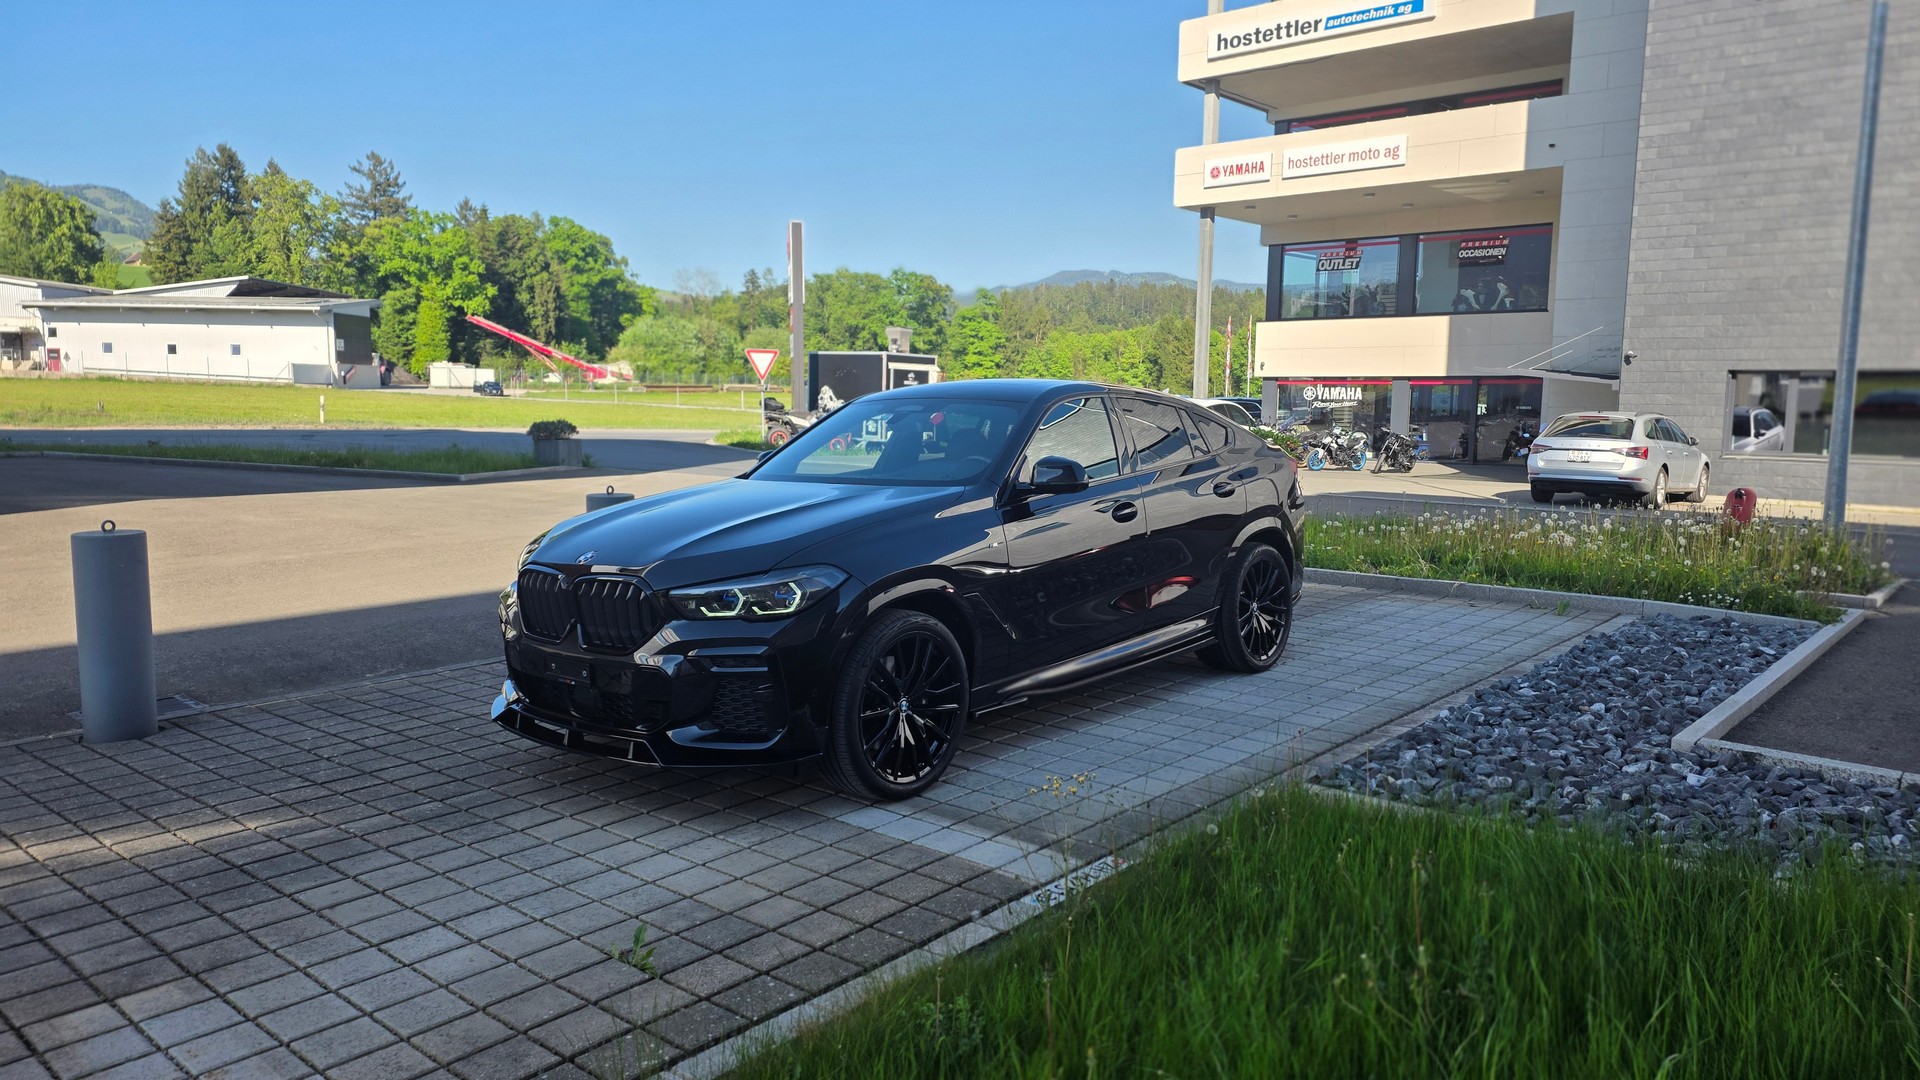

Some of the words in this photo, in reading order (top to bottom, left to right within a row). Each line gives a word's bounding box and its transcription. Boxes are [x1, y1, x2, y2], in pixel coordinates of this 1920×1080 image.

[1327, 5, 1395, 27] autotechnik
[1397, 3, 1413, 14] ag
[1217, 18, 1322, 51] hostettler
[1287, 151, 1346, 170] hostettler
[1348, 147, 1380, 163] moto
[1383, 145, 1400, 160] ag
[1222, 160, 1265, 177] YAMAHA
[1460, 239, 1509, 248] PREMIUM
[1320, 250, 1362, 258] PREMIUM
[1458, 247, 1507, 258] OCCASIONEN
[1318, 258, 1360, 270] OUTLET
[1316, 384, 1363, 400] YAMAHA
